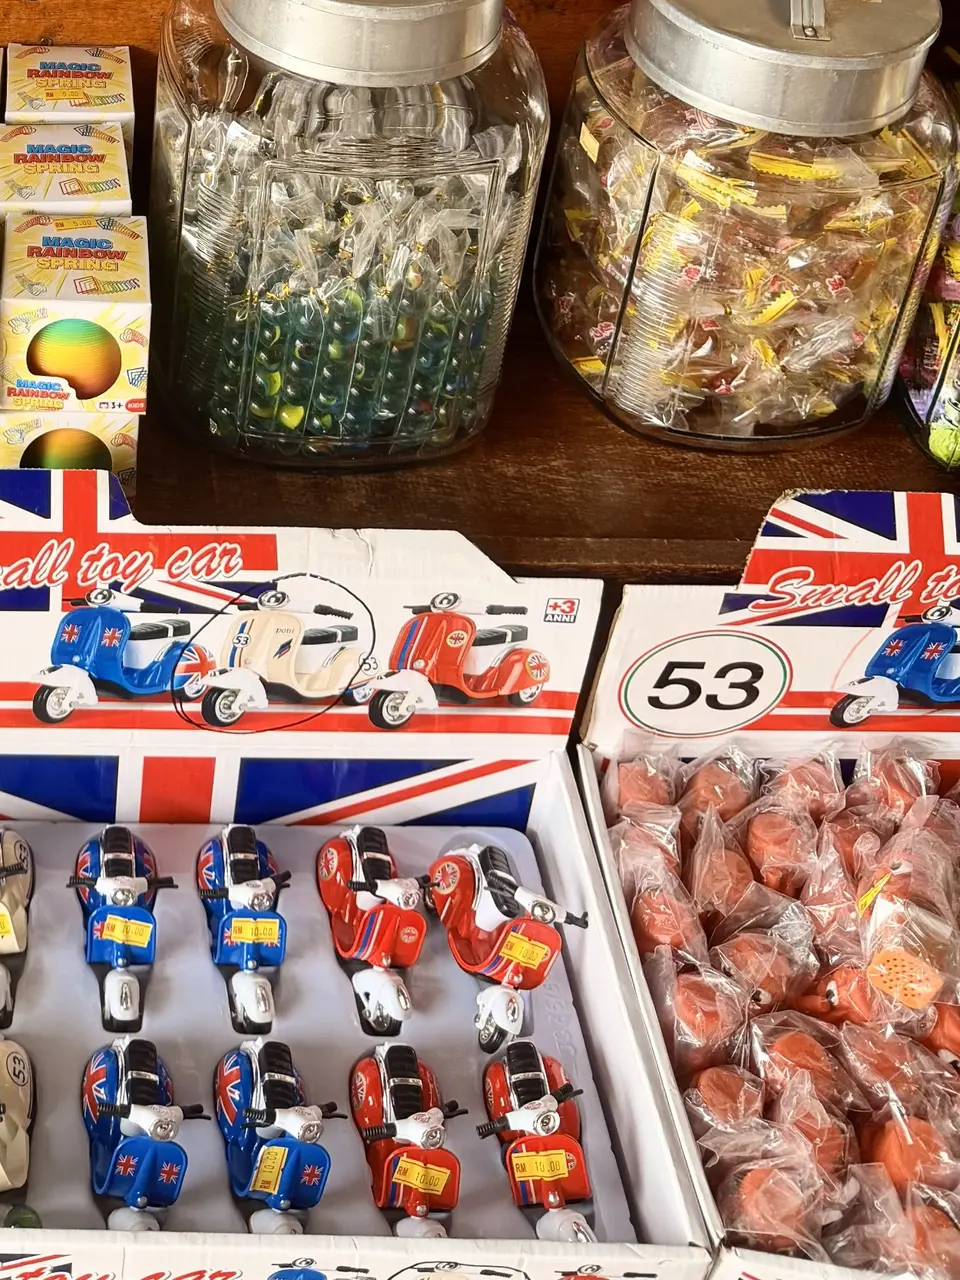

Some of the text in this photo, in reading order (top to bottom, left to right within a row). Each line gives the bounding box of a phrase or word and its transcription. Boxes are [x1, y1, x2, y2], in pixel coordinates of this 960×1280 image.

[39, 61, 101, 72] MAGIC
[26, 68, 114, 80] RAINBOW
[35, 78, 106, 89] SPRING
[26, 144, 93, 155] MAGIC
[13, 153, 107, 164] RAINBOW
[23, 163, 100, 174] SPRING
[73, 219, 92, 227] 5.00
[41, 236, 114, 250] MAGIC
[27, 246, 127, 260] RAINBOW
[36, 257, 119, 272] SPRING
[16, 379, 63, 391] MAGIC
[7, 387, 70, 400] RAINBOW
[13, 397, 65, 409] SPRING
[111, 402, 144, 410] 3+ KIDS
[77, 542, 153, 595] toy
[165, 542, 244, 582] car
[747, 560, 923, 614] Small
[548, 599, 576, 614] +3
[545, 614, 575, 623] ANNI
[233, 635, 249, 646] 53
[647, 660, 765, 711] 53
[106, 923, 145, 937] RM 10.00
[233, 926, 273, 937] RM 10.00
[11, 1055, 27, 1084] 53
[259, 1150, 276, 1191] RM 10.00
[515, 1159, 561, 1172] RM 10.00
[397, 1165, 440, 1189] RM 10.00
